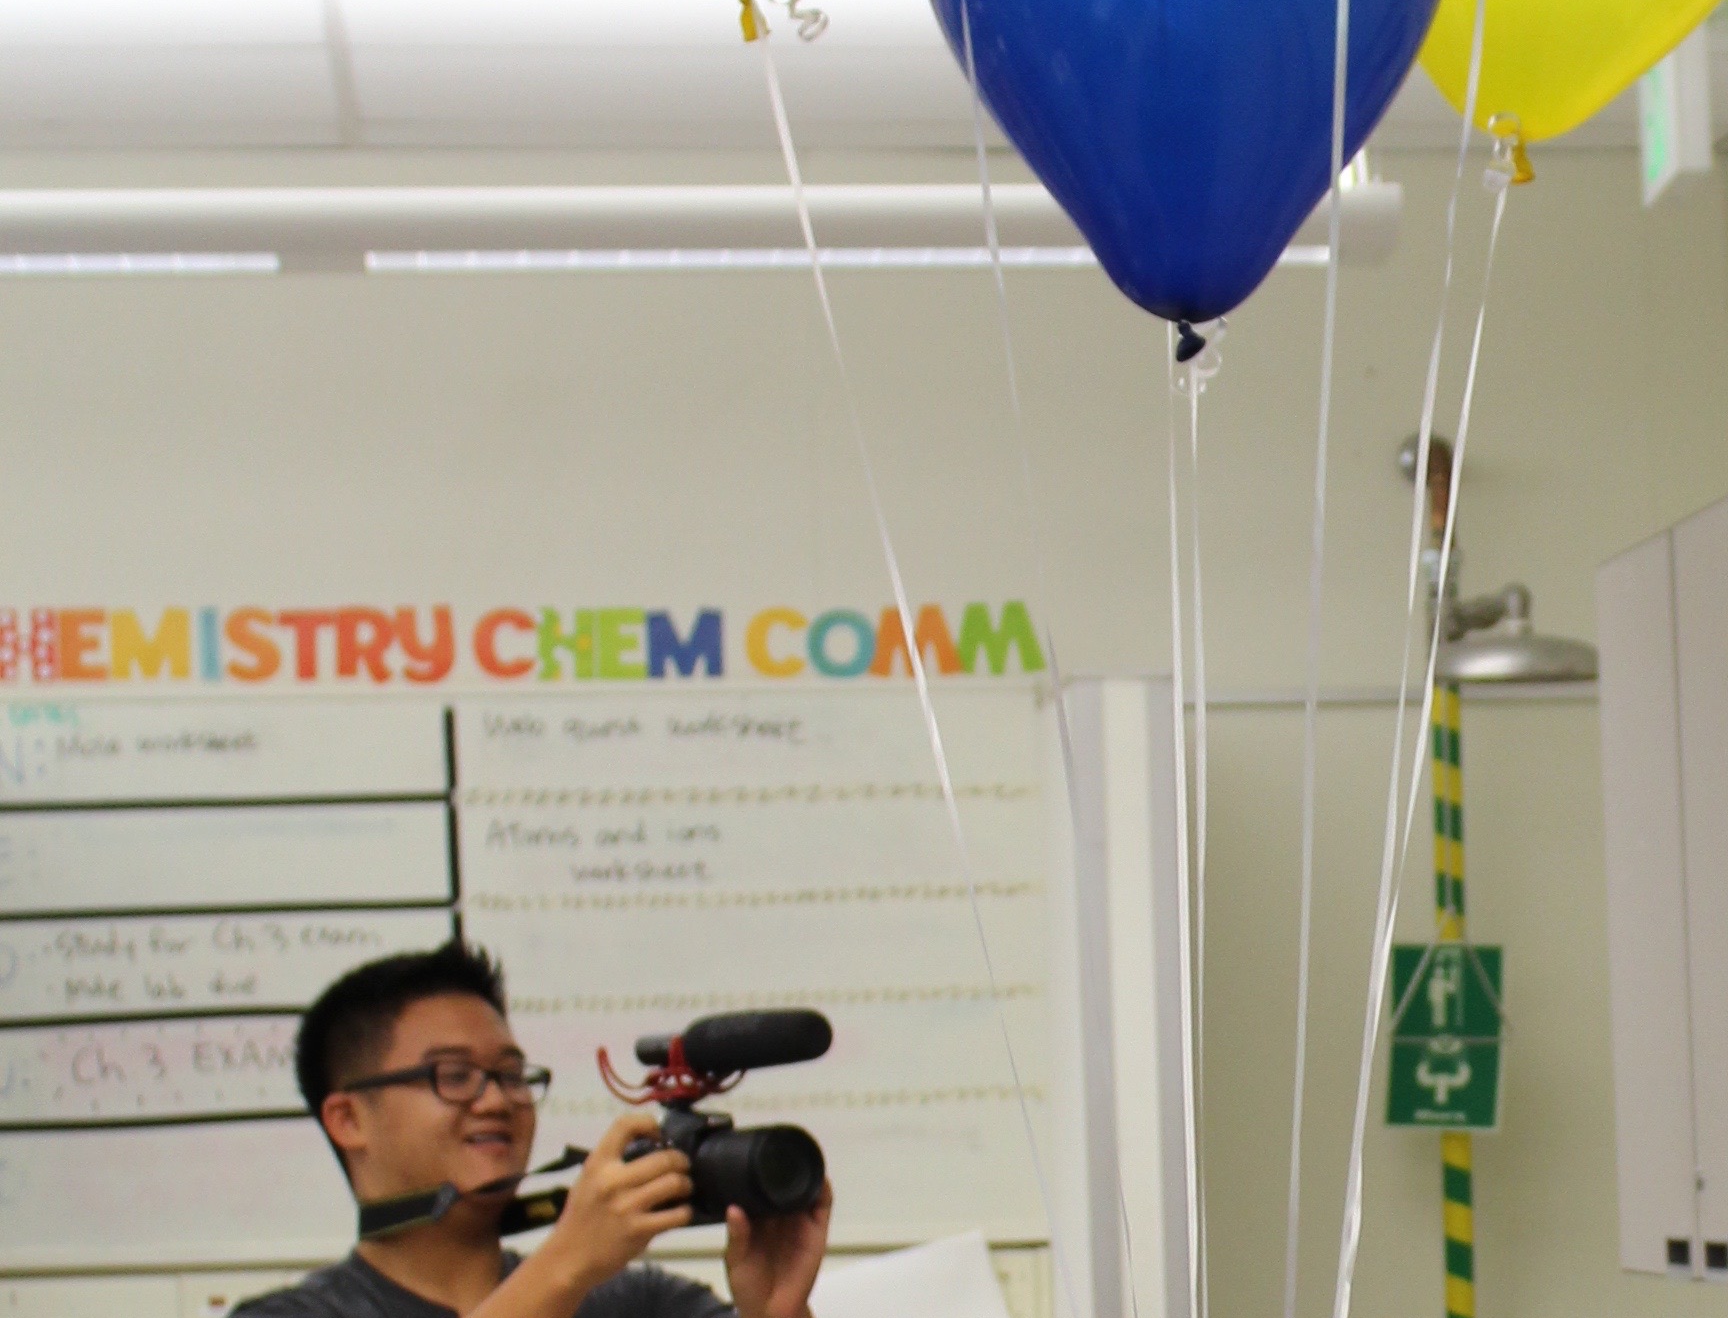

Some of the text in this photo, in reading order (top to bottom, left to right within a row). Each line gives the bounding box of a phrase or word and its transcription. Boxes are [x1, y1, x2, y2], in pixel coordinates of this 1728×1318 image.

[0, 600, 1046, 680] HEMISTRY CHEM COMM
